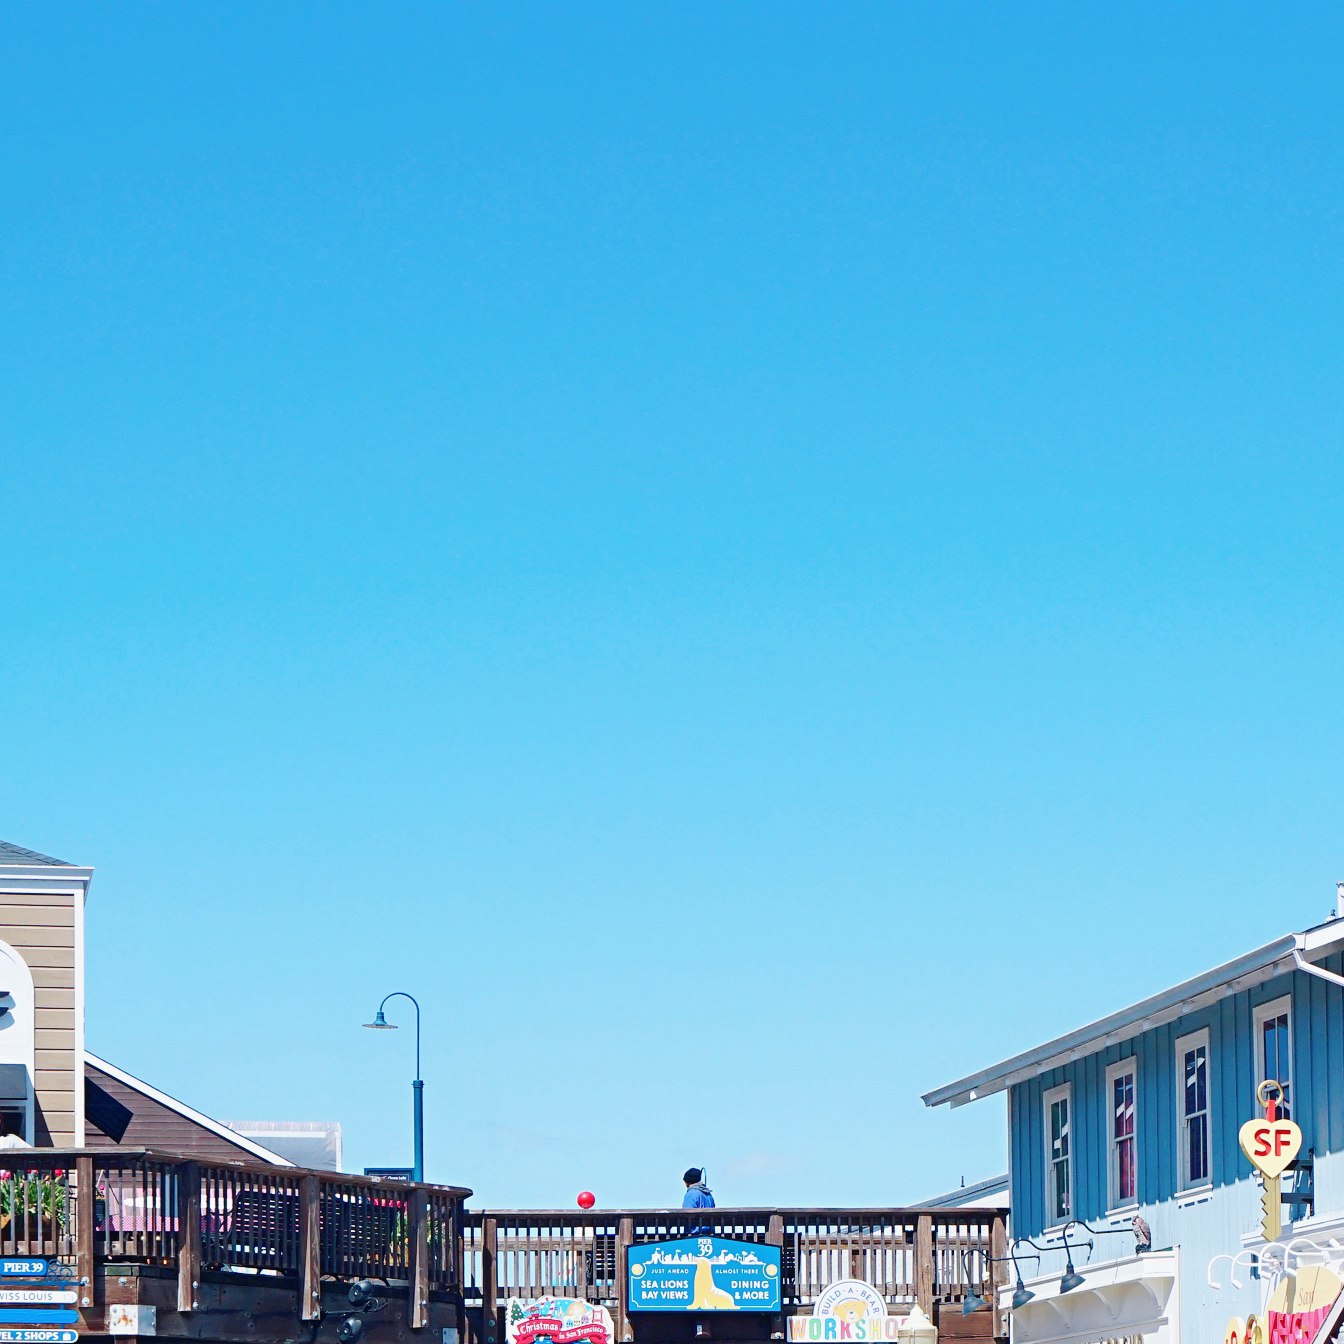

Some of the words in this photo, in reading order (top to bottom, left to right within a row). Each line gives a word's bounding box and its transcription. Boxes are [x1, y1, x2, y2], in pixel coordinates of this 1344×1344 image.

[1254, 1128, 1291, 1157] SF
[697, 1244, 713, 1257] 39
[3, 1262, 31, 1273] PIER
[30, 1262, 44, 1273] 39
[641, 1280, 657, 1289] SEA
[660, 1280, 689, 1289] LIONS
[731, 1280, 770, 1289] DINING
[23, 1292, 54, 1301] LOUIS
[641, 1291, 658, 1300] BAY
[660, 1291, 689, 1300] VIEWS
[734, 1291, 741, 1300] &
[742, 1291, 770, 1300] MORE
[519, 1323, 559, 1334] Christmas
[566, 1331, 577, 1339] San
[577, 1326, 604, 1337] Francisco
[789, 1317, 908, 1340] WORKSHO
[16, 1331, 23, 1341] 2
[24, 1331, 59, 1341] SHOPS
